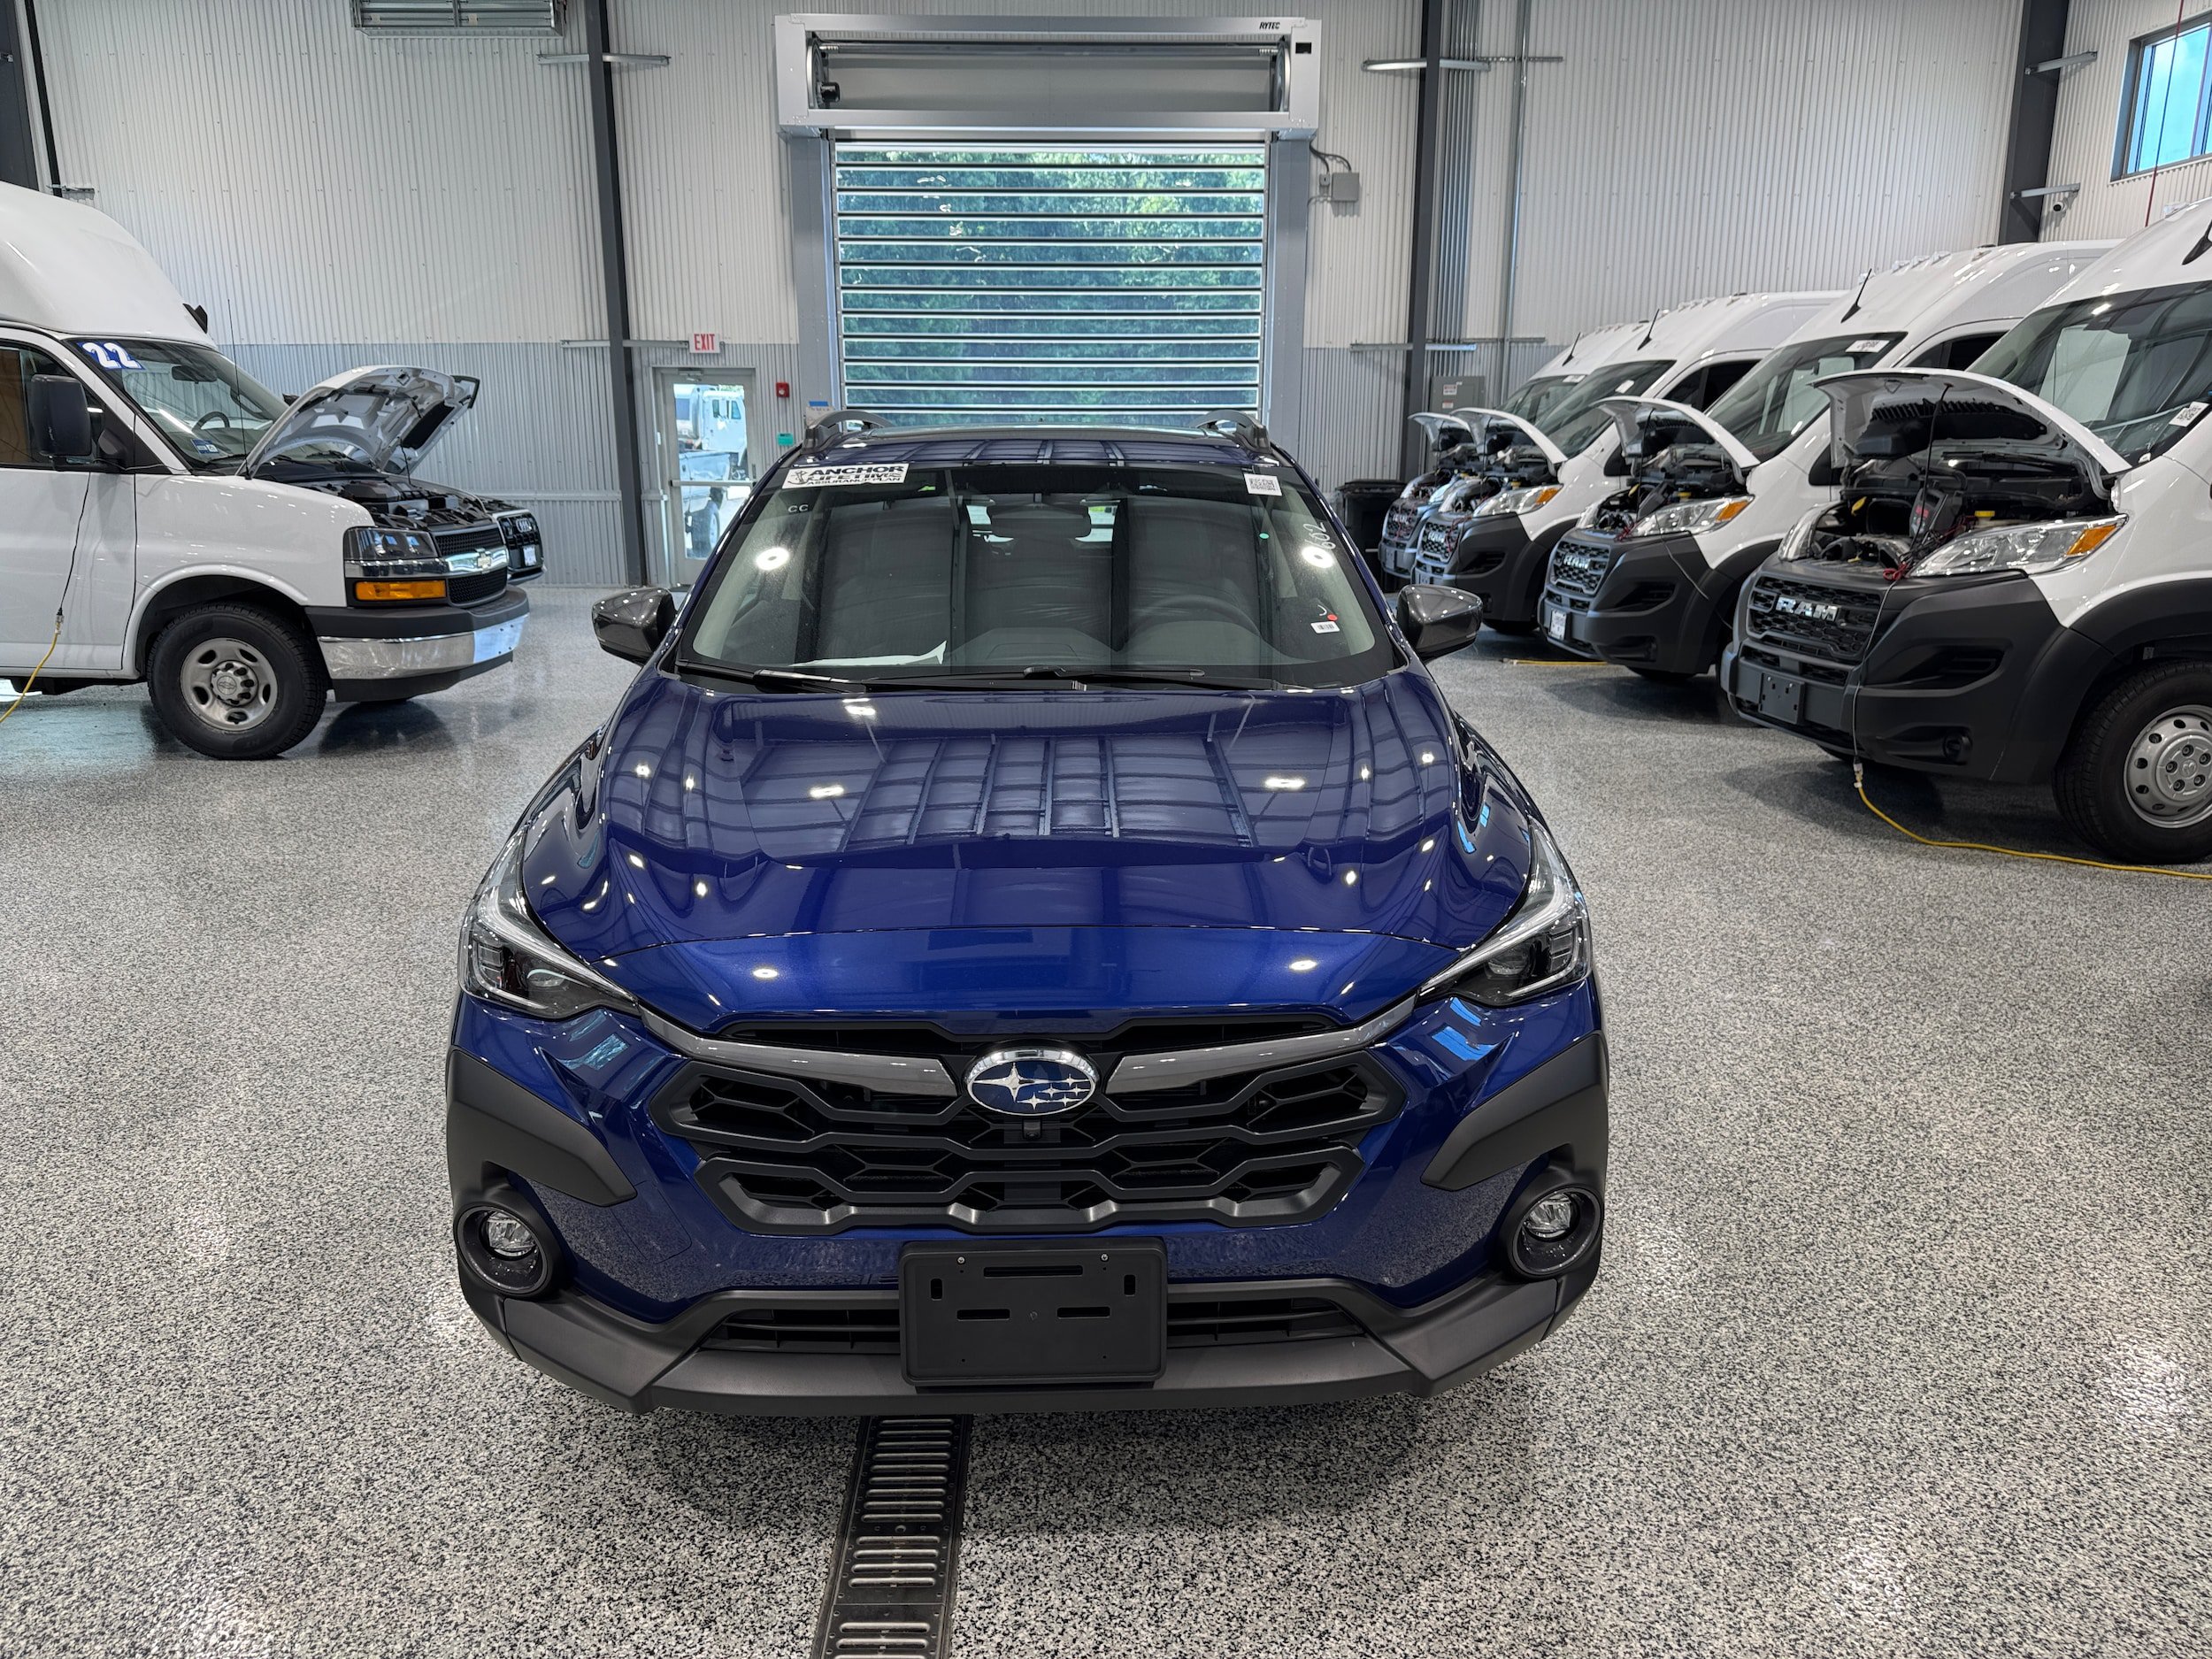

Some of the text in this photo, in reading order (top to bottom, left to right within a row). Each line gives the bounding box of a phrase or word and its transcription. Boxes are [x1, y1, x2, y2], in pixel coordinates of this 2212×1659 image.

[1259, 21, 1280, 30] RYTEC
[694, 333, 715, 350] EXIT
[81, 342, 142, 369] 22
[809, 465, 904, 476] ANCHOR
[787, 503, 809, 513] CC
[1563, 555, 1592, 570] RAM
[1775, 596, 1839, 622] RAM
